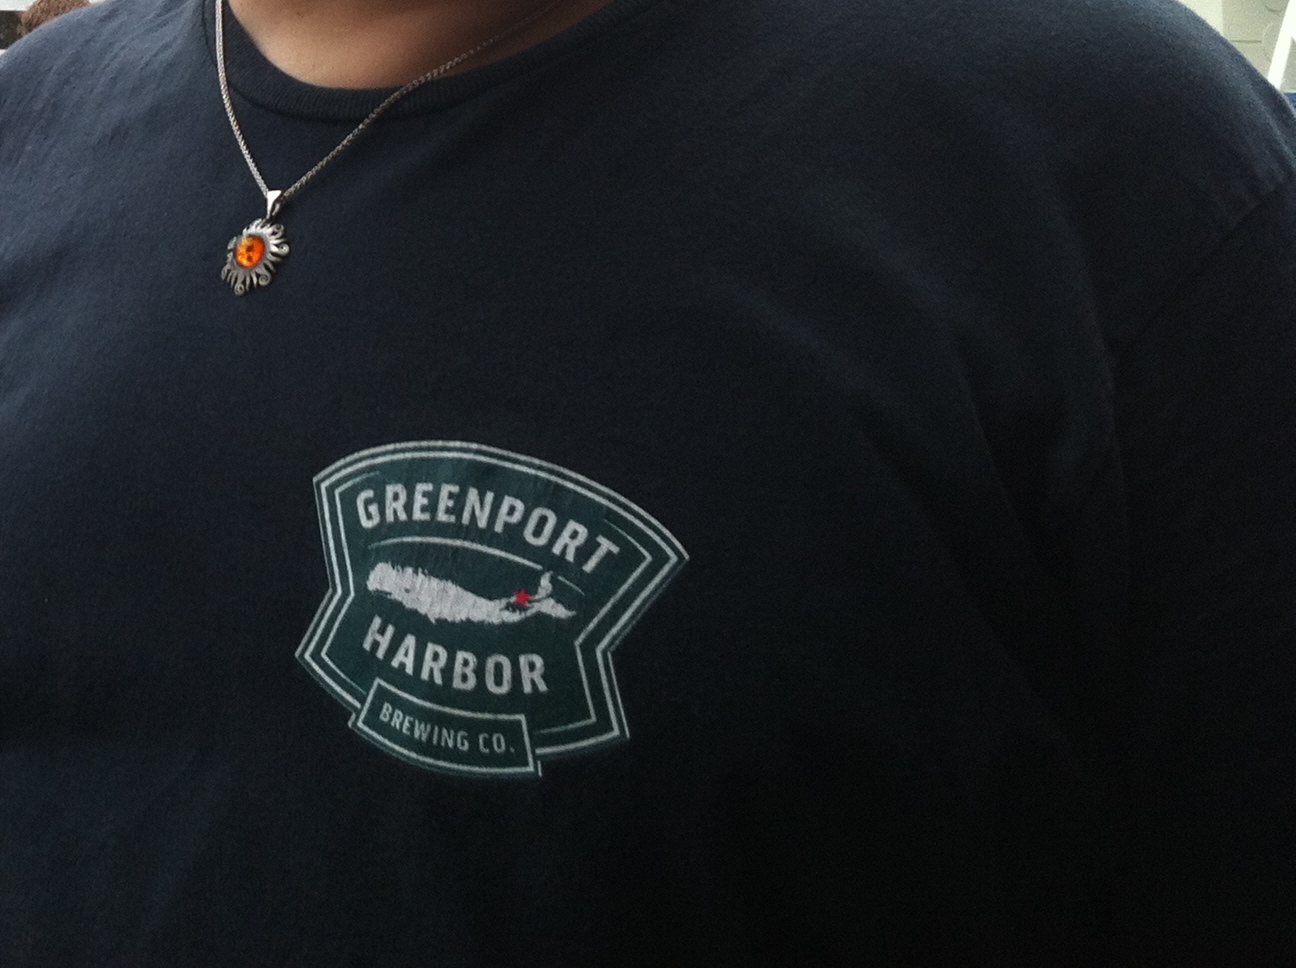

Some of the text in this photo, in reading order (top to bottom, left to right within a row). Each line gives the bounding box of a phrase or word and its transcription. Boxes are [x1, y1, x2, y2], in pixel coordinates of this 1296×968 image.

[356, 482, 621, 574] GREENPORT
[362, 614, 549, 695] HARBOR
[379, 702, 516, 754] BREWING CO.
